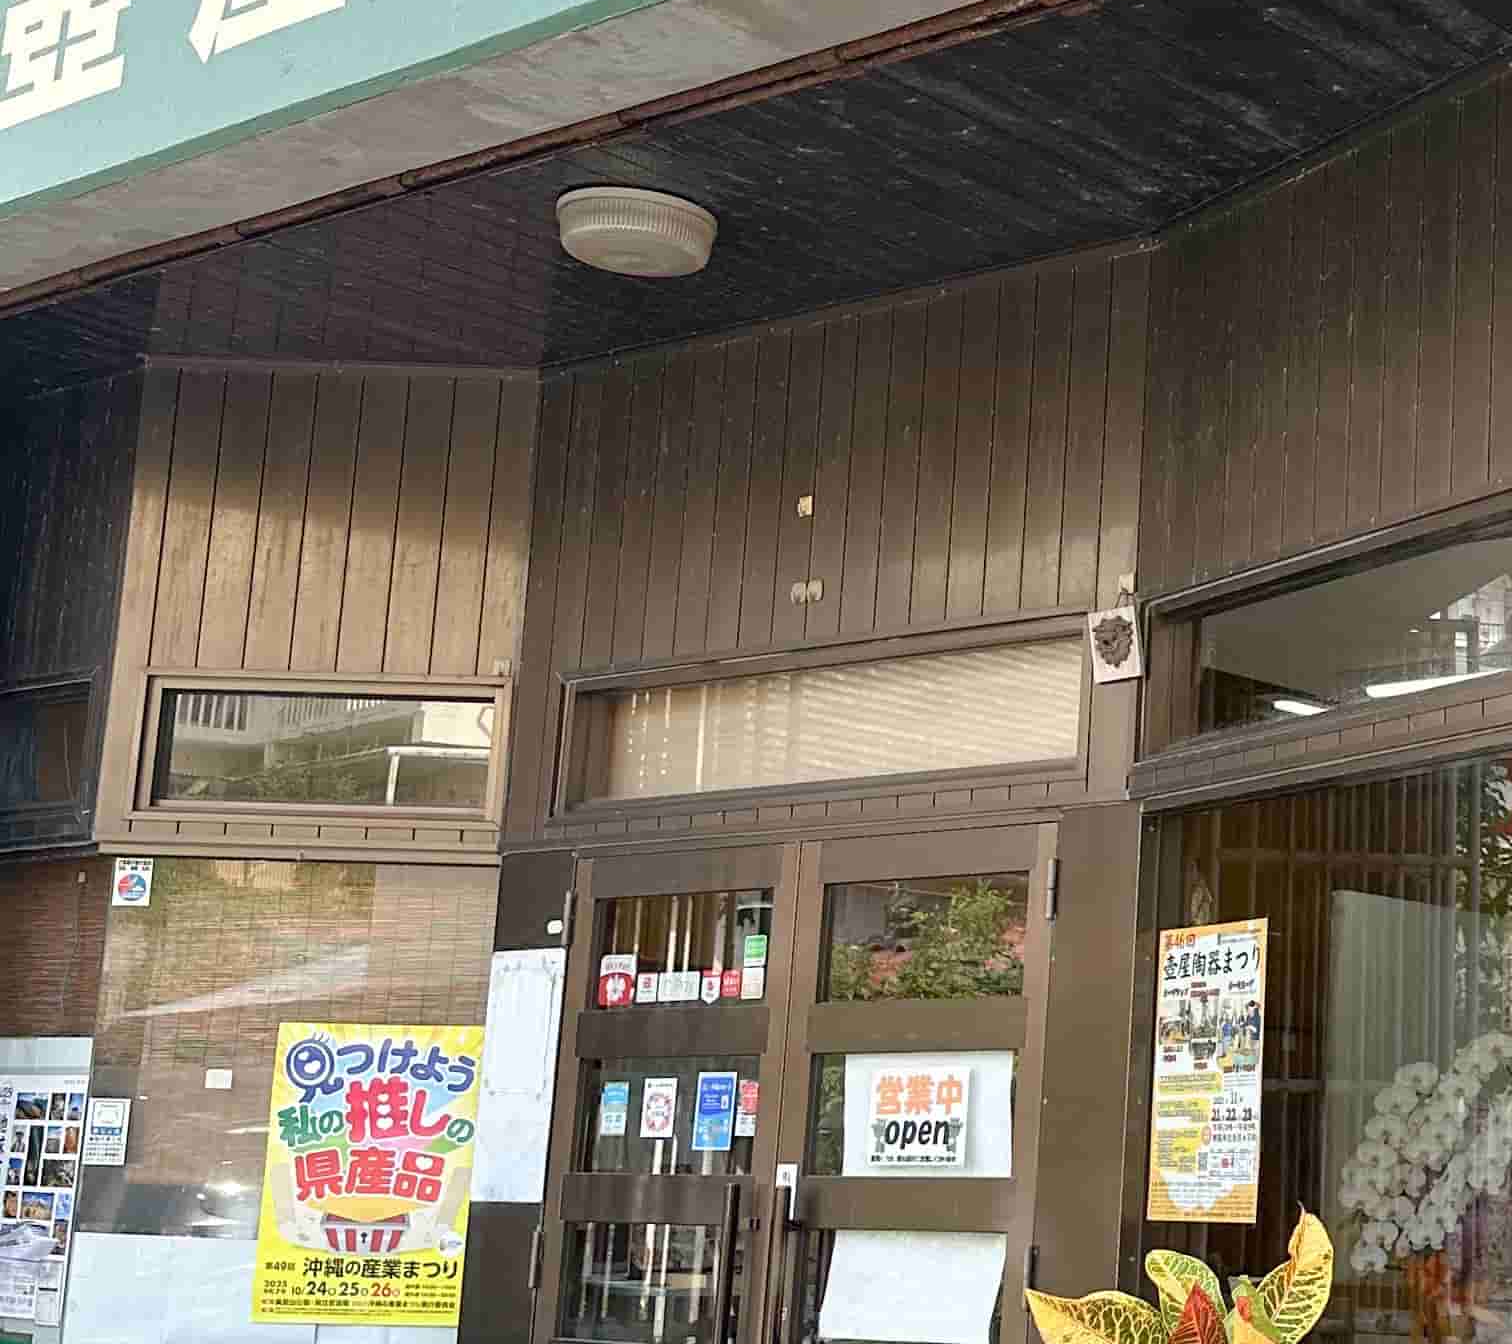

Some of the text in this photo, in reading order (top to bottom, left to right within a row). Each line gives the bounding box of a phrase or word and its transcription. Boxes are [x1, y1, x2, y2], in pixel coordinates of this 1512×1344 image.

[286, 1038, 476, 1103] 見つけよう
[876, 1073, 963, 1115] 営業中
[277, 1075, 475, 1147] 私の推しの
[884, 1119, 950, 1150] open
[294, 1146, 446, 1202] 県産品
[302, 1256, 459, 1280] 沖縄の産業まつり
